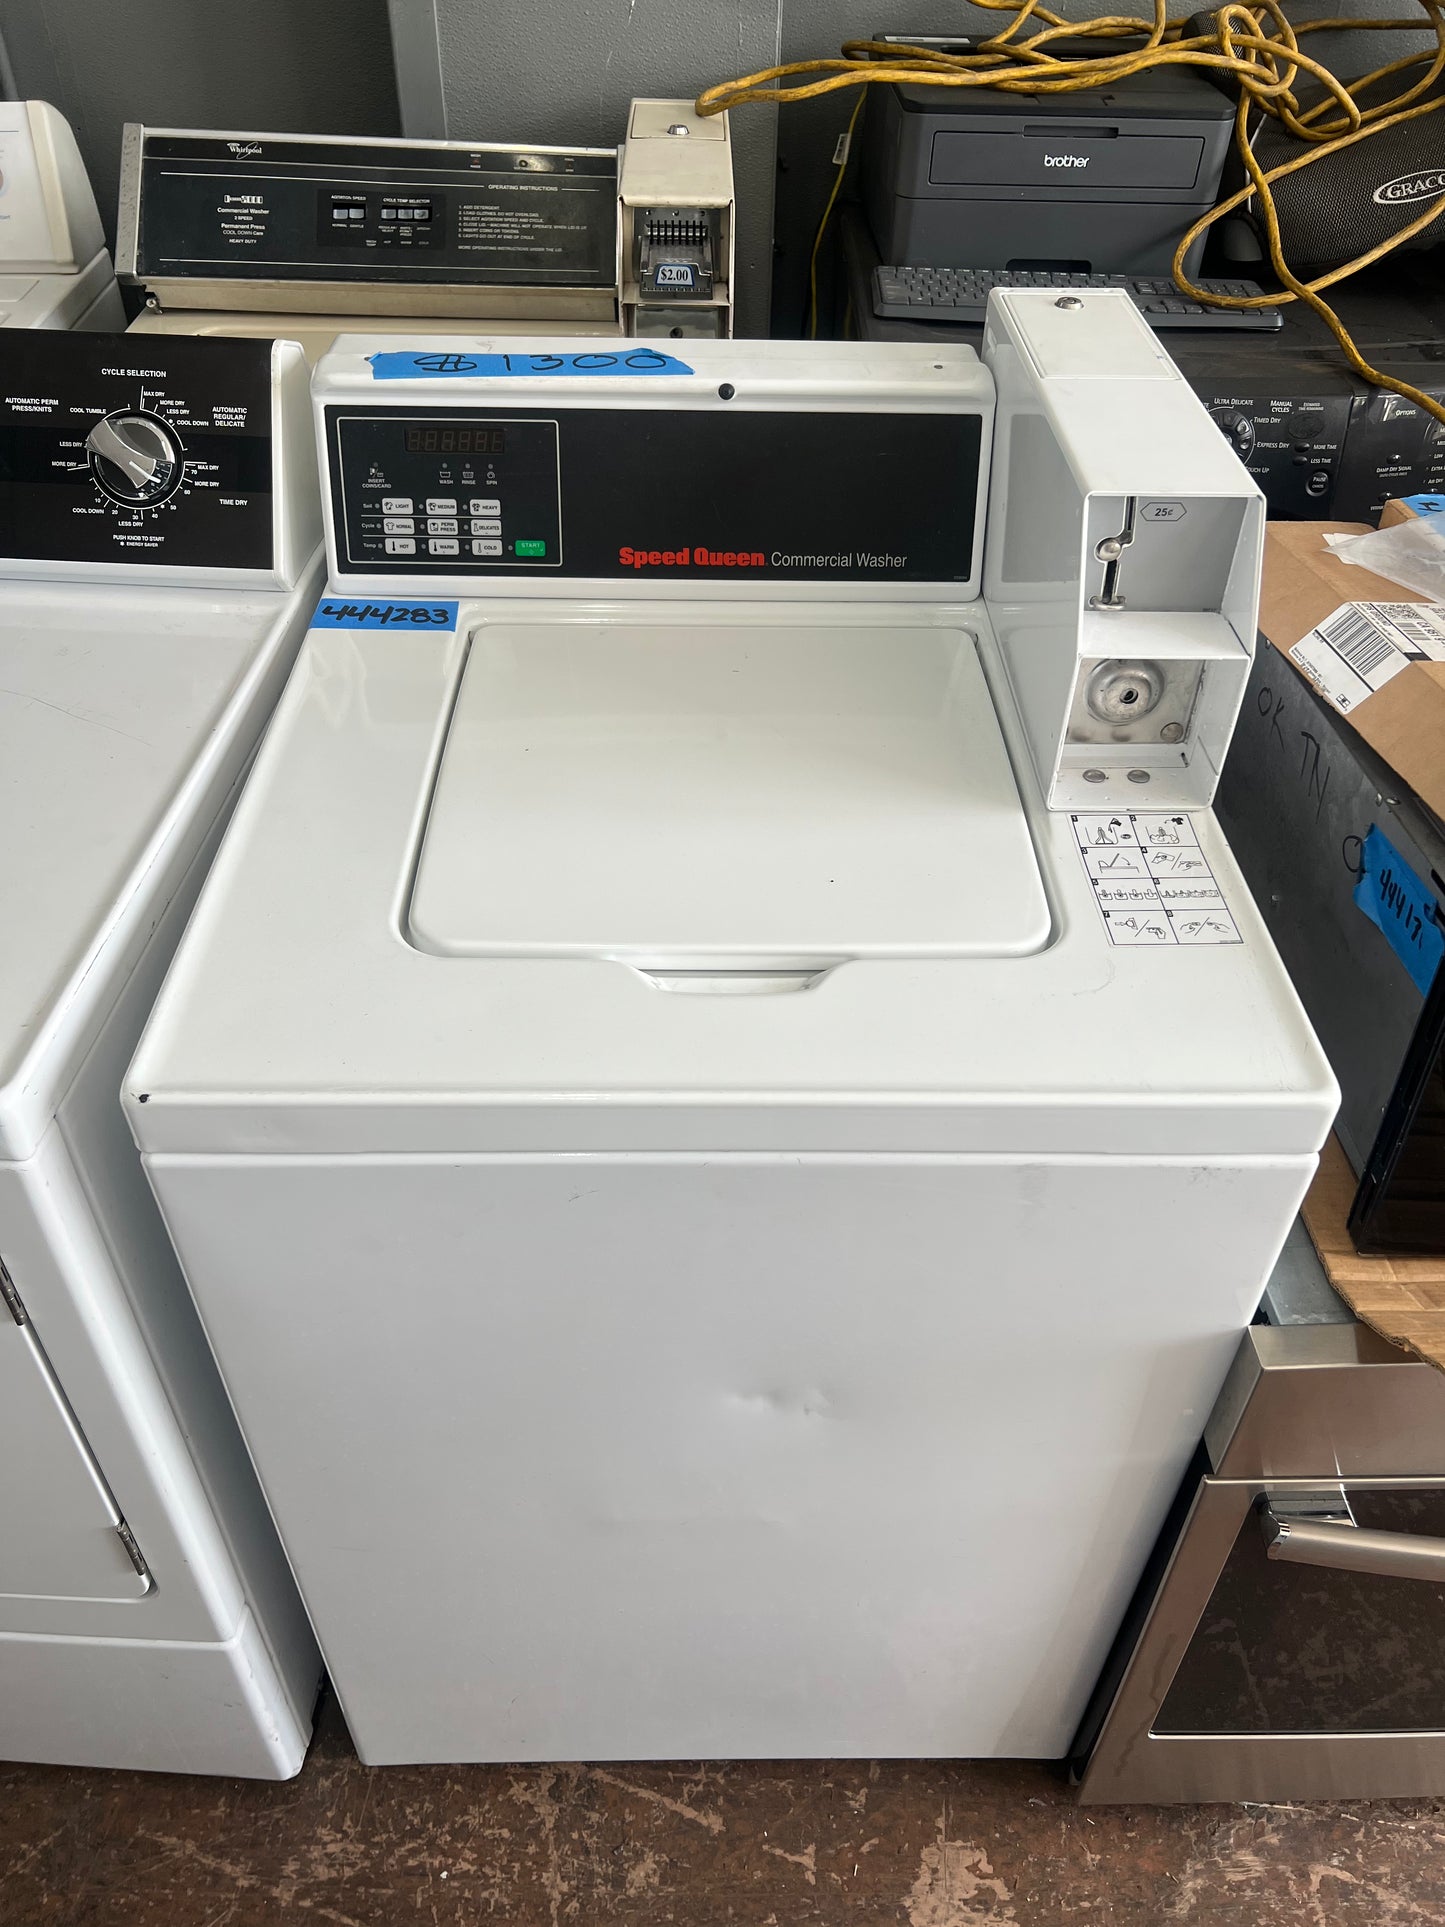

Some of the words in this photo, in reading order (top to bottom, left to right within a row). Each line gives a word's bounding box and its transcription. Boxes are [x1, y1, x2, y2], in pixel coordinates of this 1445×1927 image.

[1044, 154, 1090, 169] brother
[660, 268, 688, 282] $2.00
[101, 368, 125, 376] CYCLE
[126, 369, 166, 378] SELECTION
[619, 547, 690, 568] Speed
[694, 548, 766, 568] Queen
[770, 552, 852, 568] Commercial
[856, 553, 908, 568] Washer
[322, 605, 450, 624] 444283
